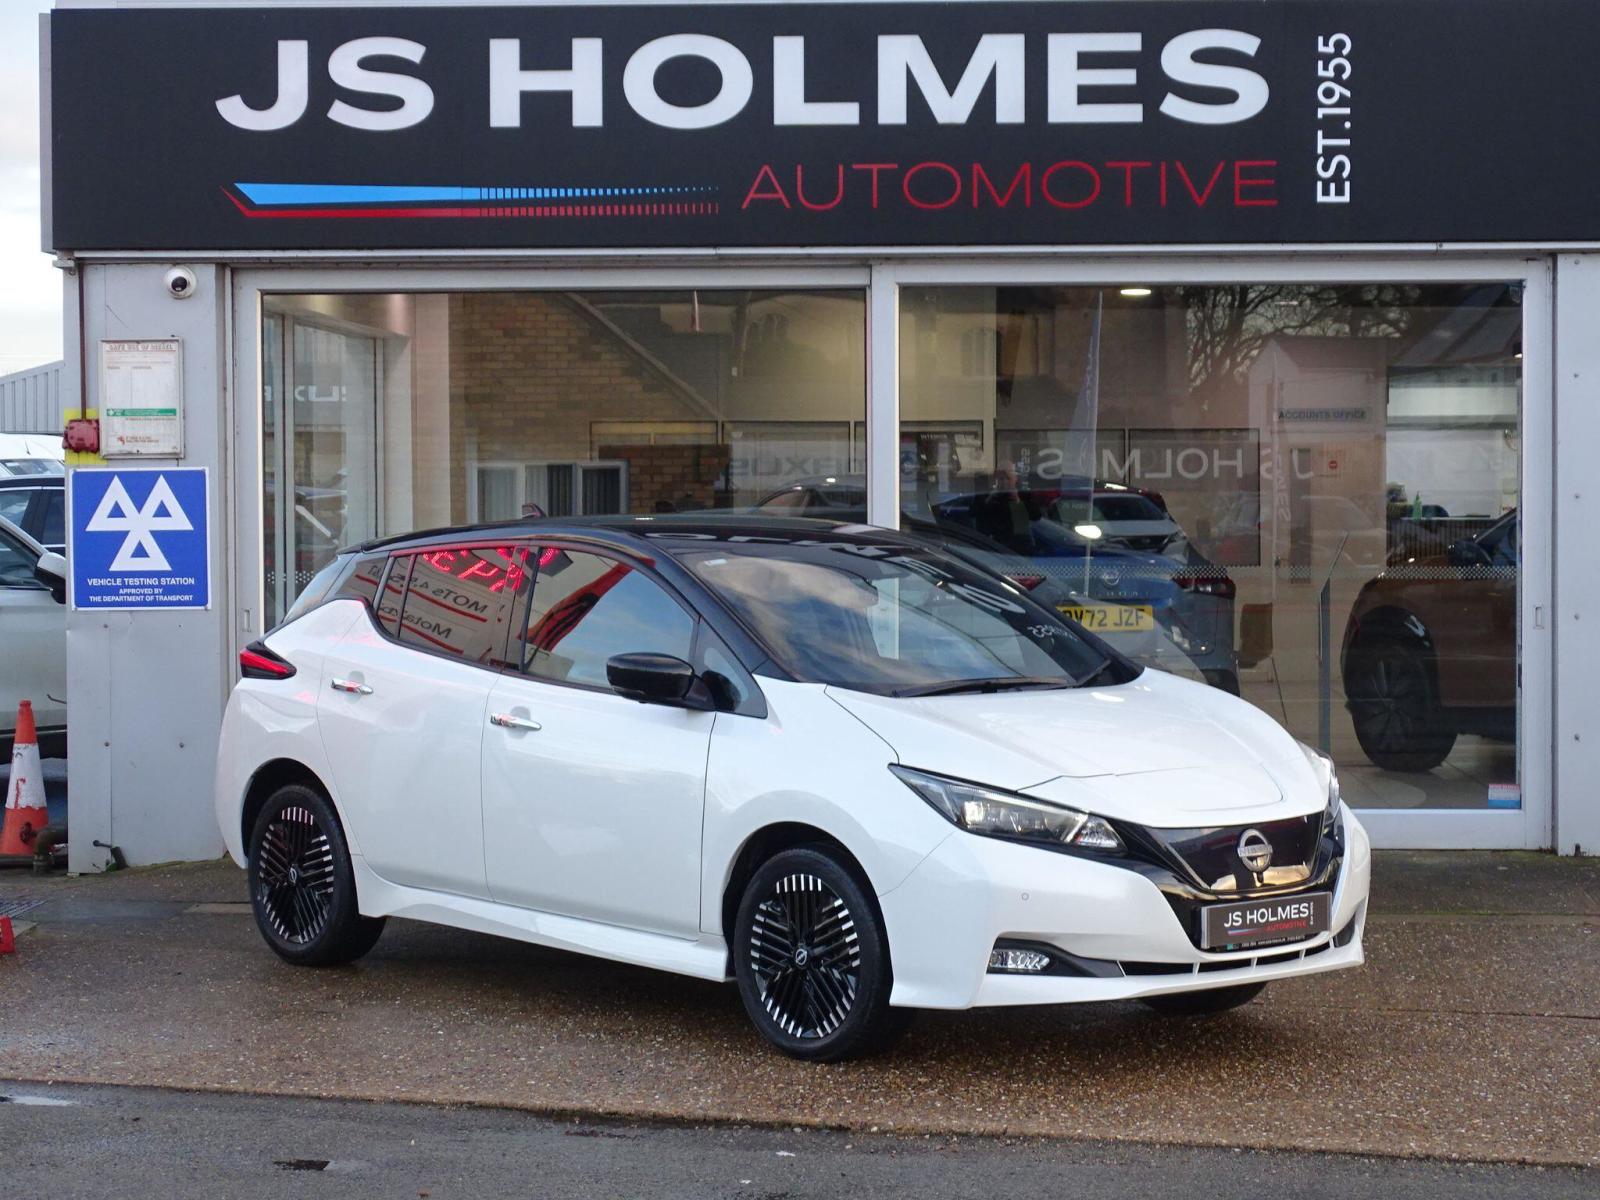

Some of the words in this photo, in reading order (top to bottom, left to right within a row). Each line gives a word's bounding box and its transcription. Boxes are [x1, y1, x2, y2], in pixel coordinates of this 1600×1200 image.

[215, 37, 435, 132] JS
[489, 28, 1270, 129] HOLMES
[1316, 32, 1352, 204] EST.1955
[740, 159, 1279, 212] AUTOMOTIVE
[87, 578, 122, 586] VEHICLE
[160, 577, 195, 585] STATION
[1113, 608, 1145, 626] JZF
[1223, 911, 1242, 928] JS
[1246, 902, 1309, 925] HOLMES
